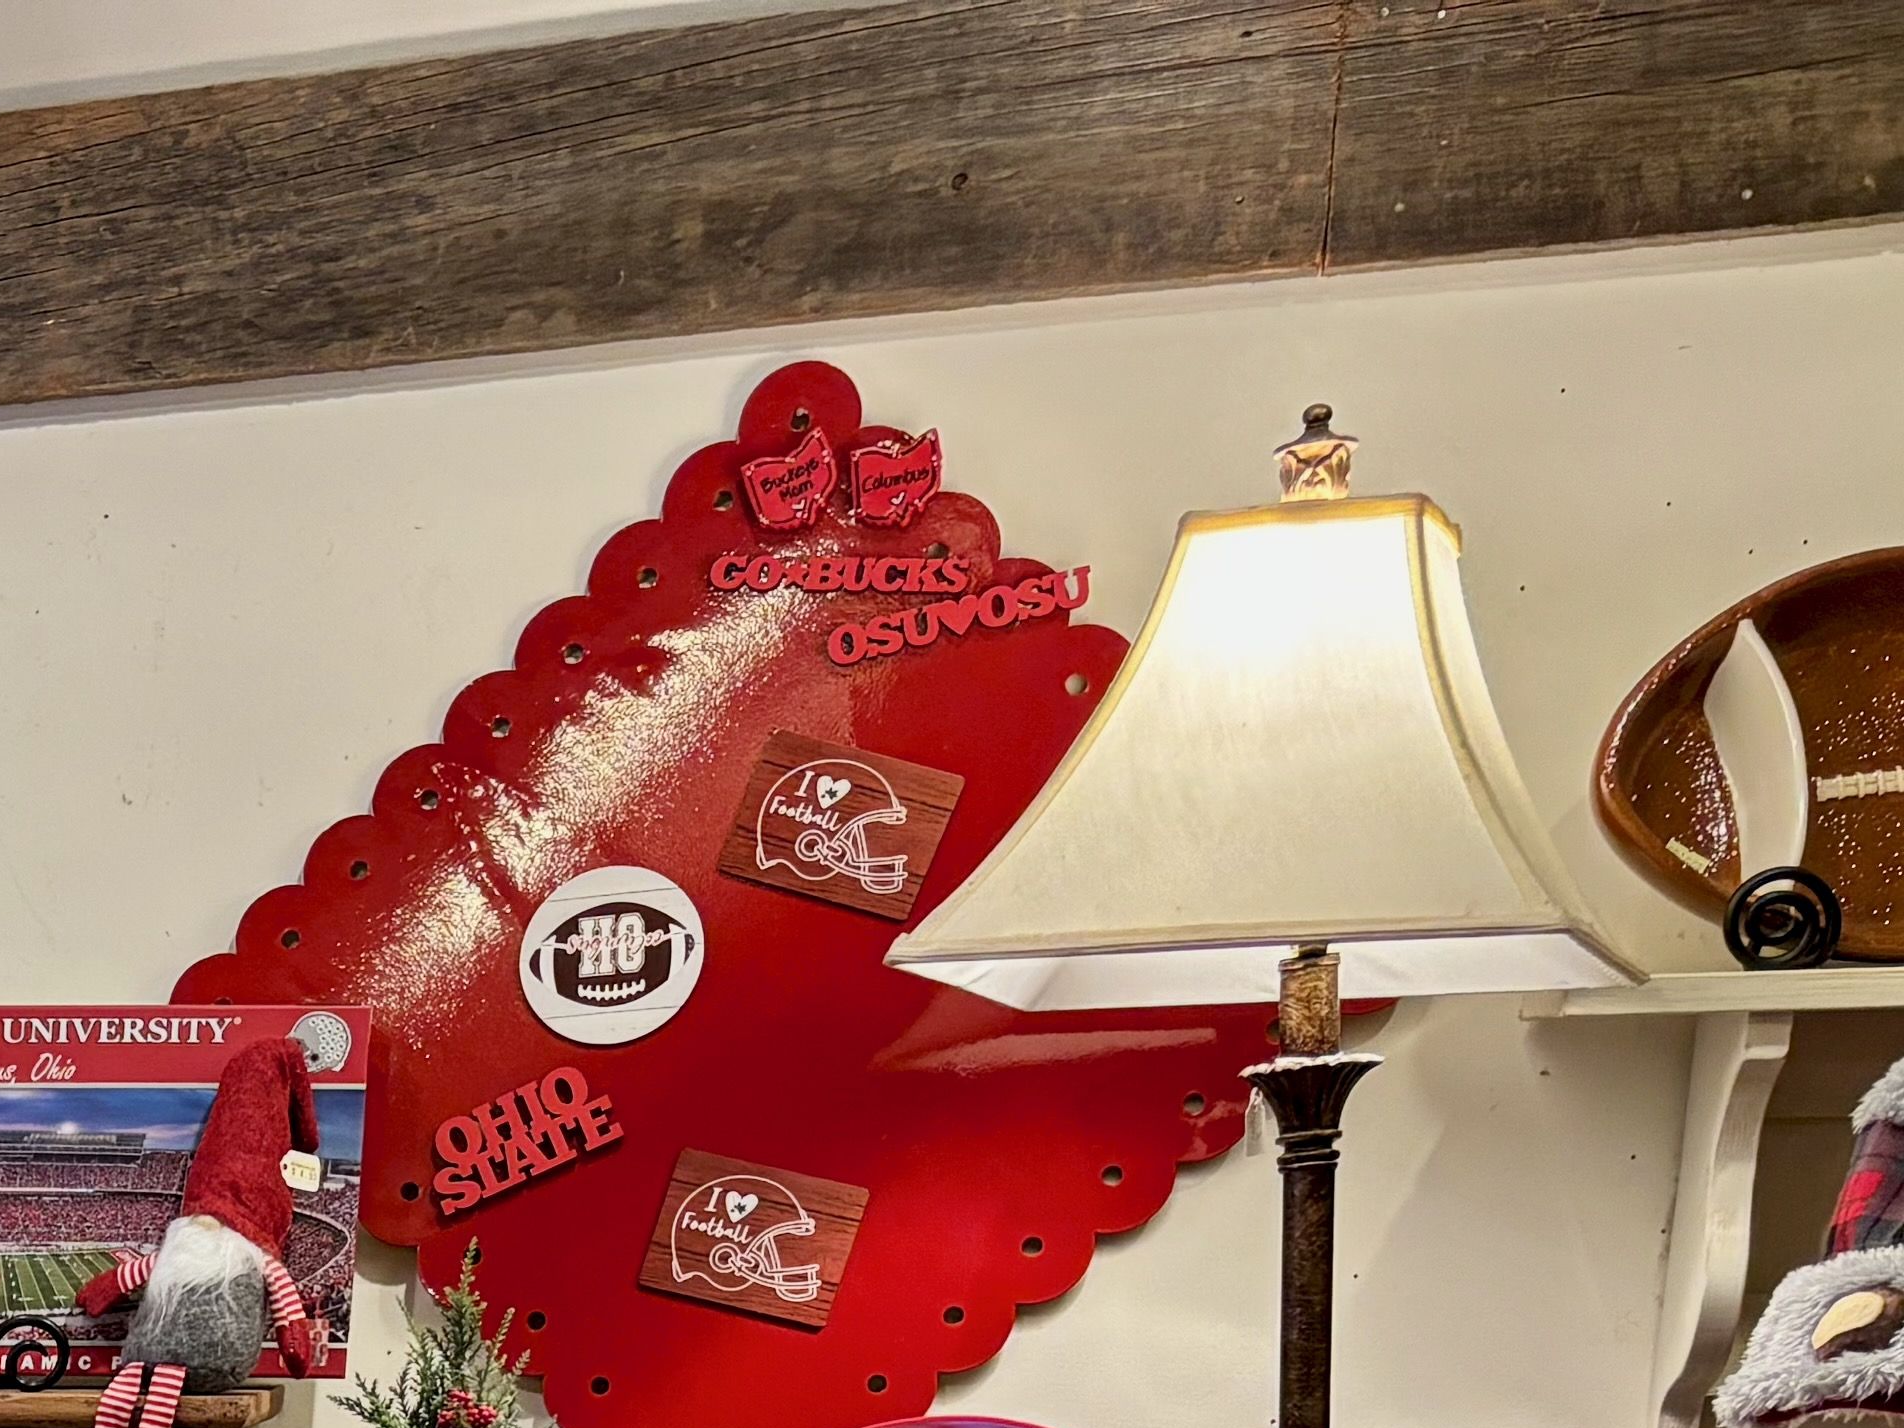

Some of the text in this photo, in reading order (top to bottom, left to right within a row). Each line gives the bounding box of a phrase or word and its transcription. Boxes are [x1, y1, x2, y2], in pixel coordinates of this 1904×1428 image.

[759, 456, 821, 494] Buckeye
[778, 479, 816, 504] Mom
[860, 463, 931, 496] Columbus
[767, 796, 844, 833] Football
[1, 1014, 234, 1046] UNIVERSITY
[30, 1052, 77, 1083] Ohio
[433, 1066, 590, 1165] OHIO
[433, 1093, 624, 1216] STATE
[681, 1210, 752, 1245] Football
